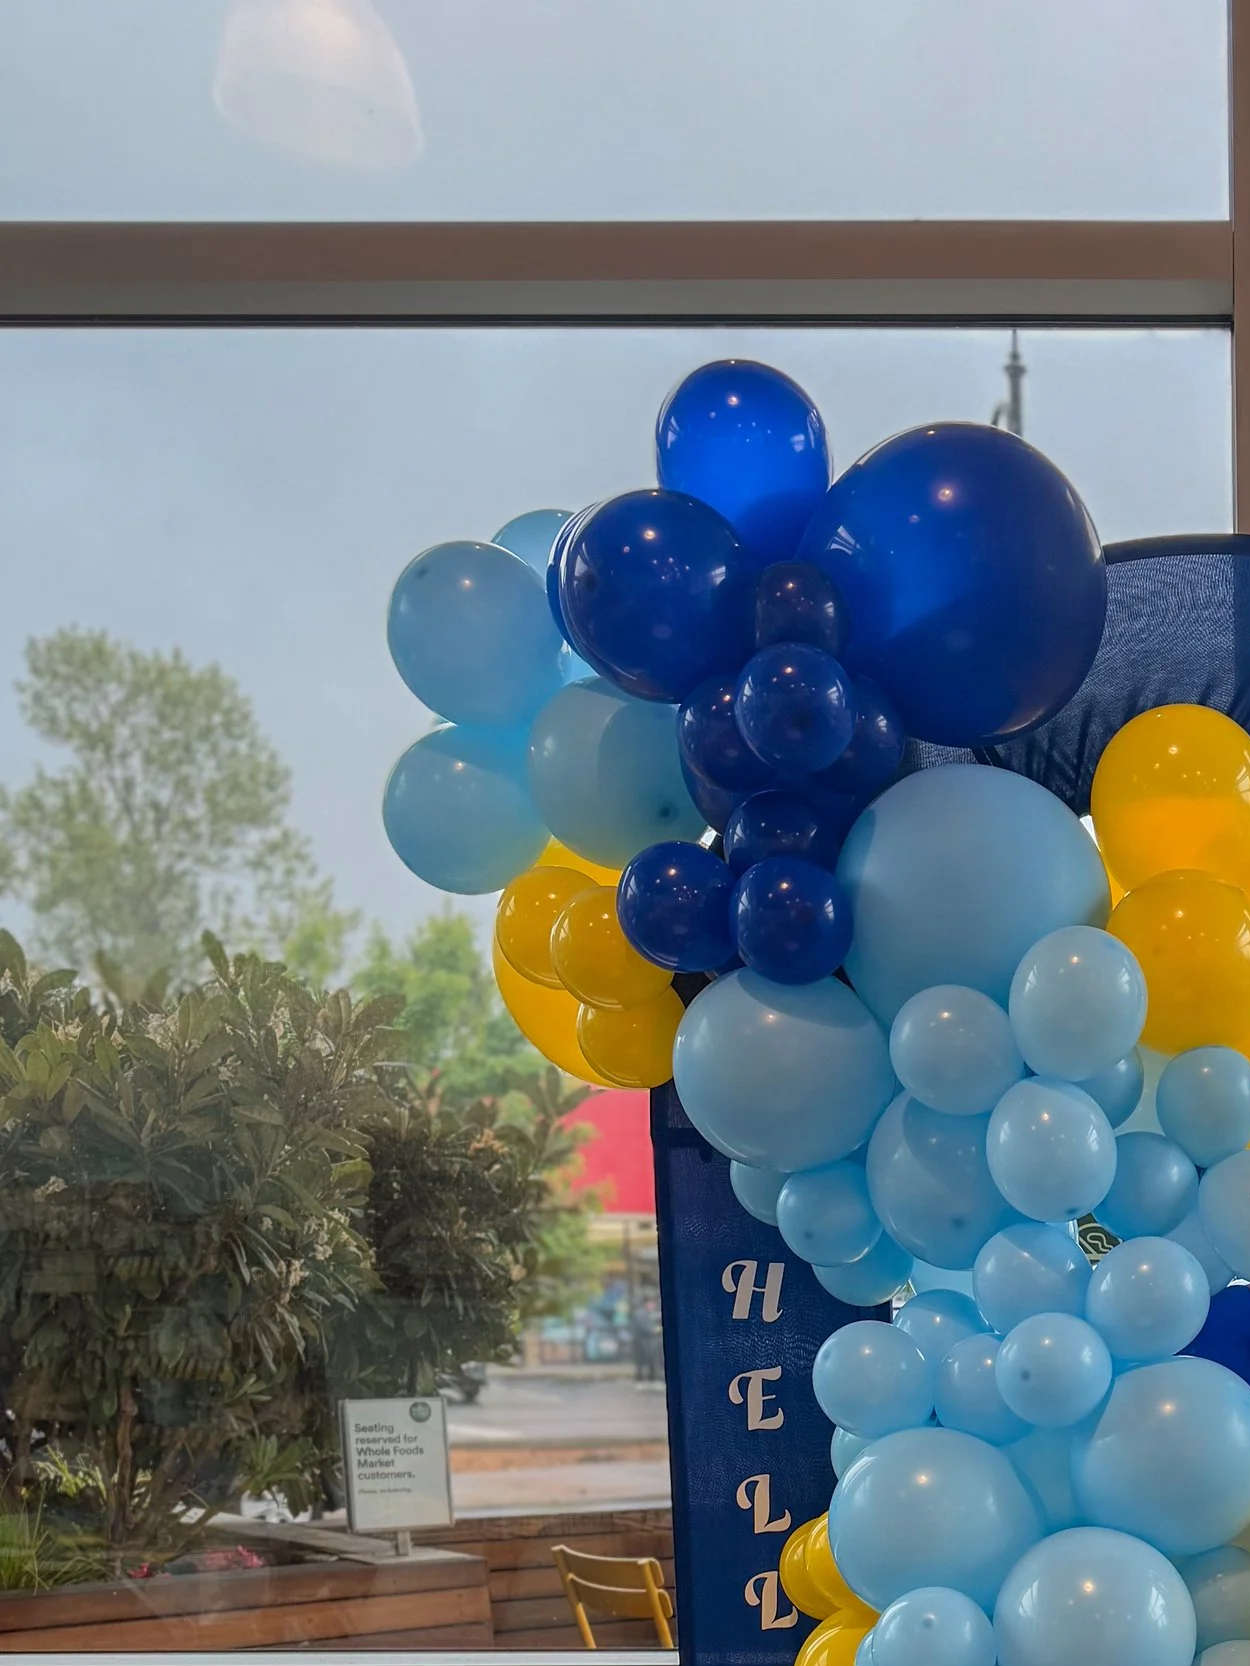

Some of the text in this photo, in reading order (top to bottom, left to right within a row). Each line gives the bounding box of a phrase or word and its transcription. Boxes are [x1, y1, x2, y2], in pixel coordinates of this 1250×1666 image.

[354, 1423, 394, 1434] Seating
[356, 1433, 418, 1445] reserved for
[356, 1445, 424, 1457] Whole Foods
[358, 1458, 395, 1468] Market
[358, 1471, 415, 1480] customers.
